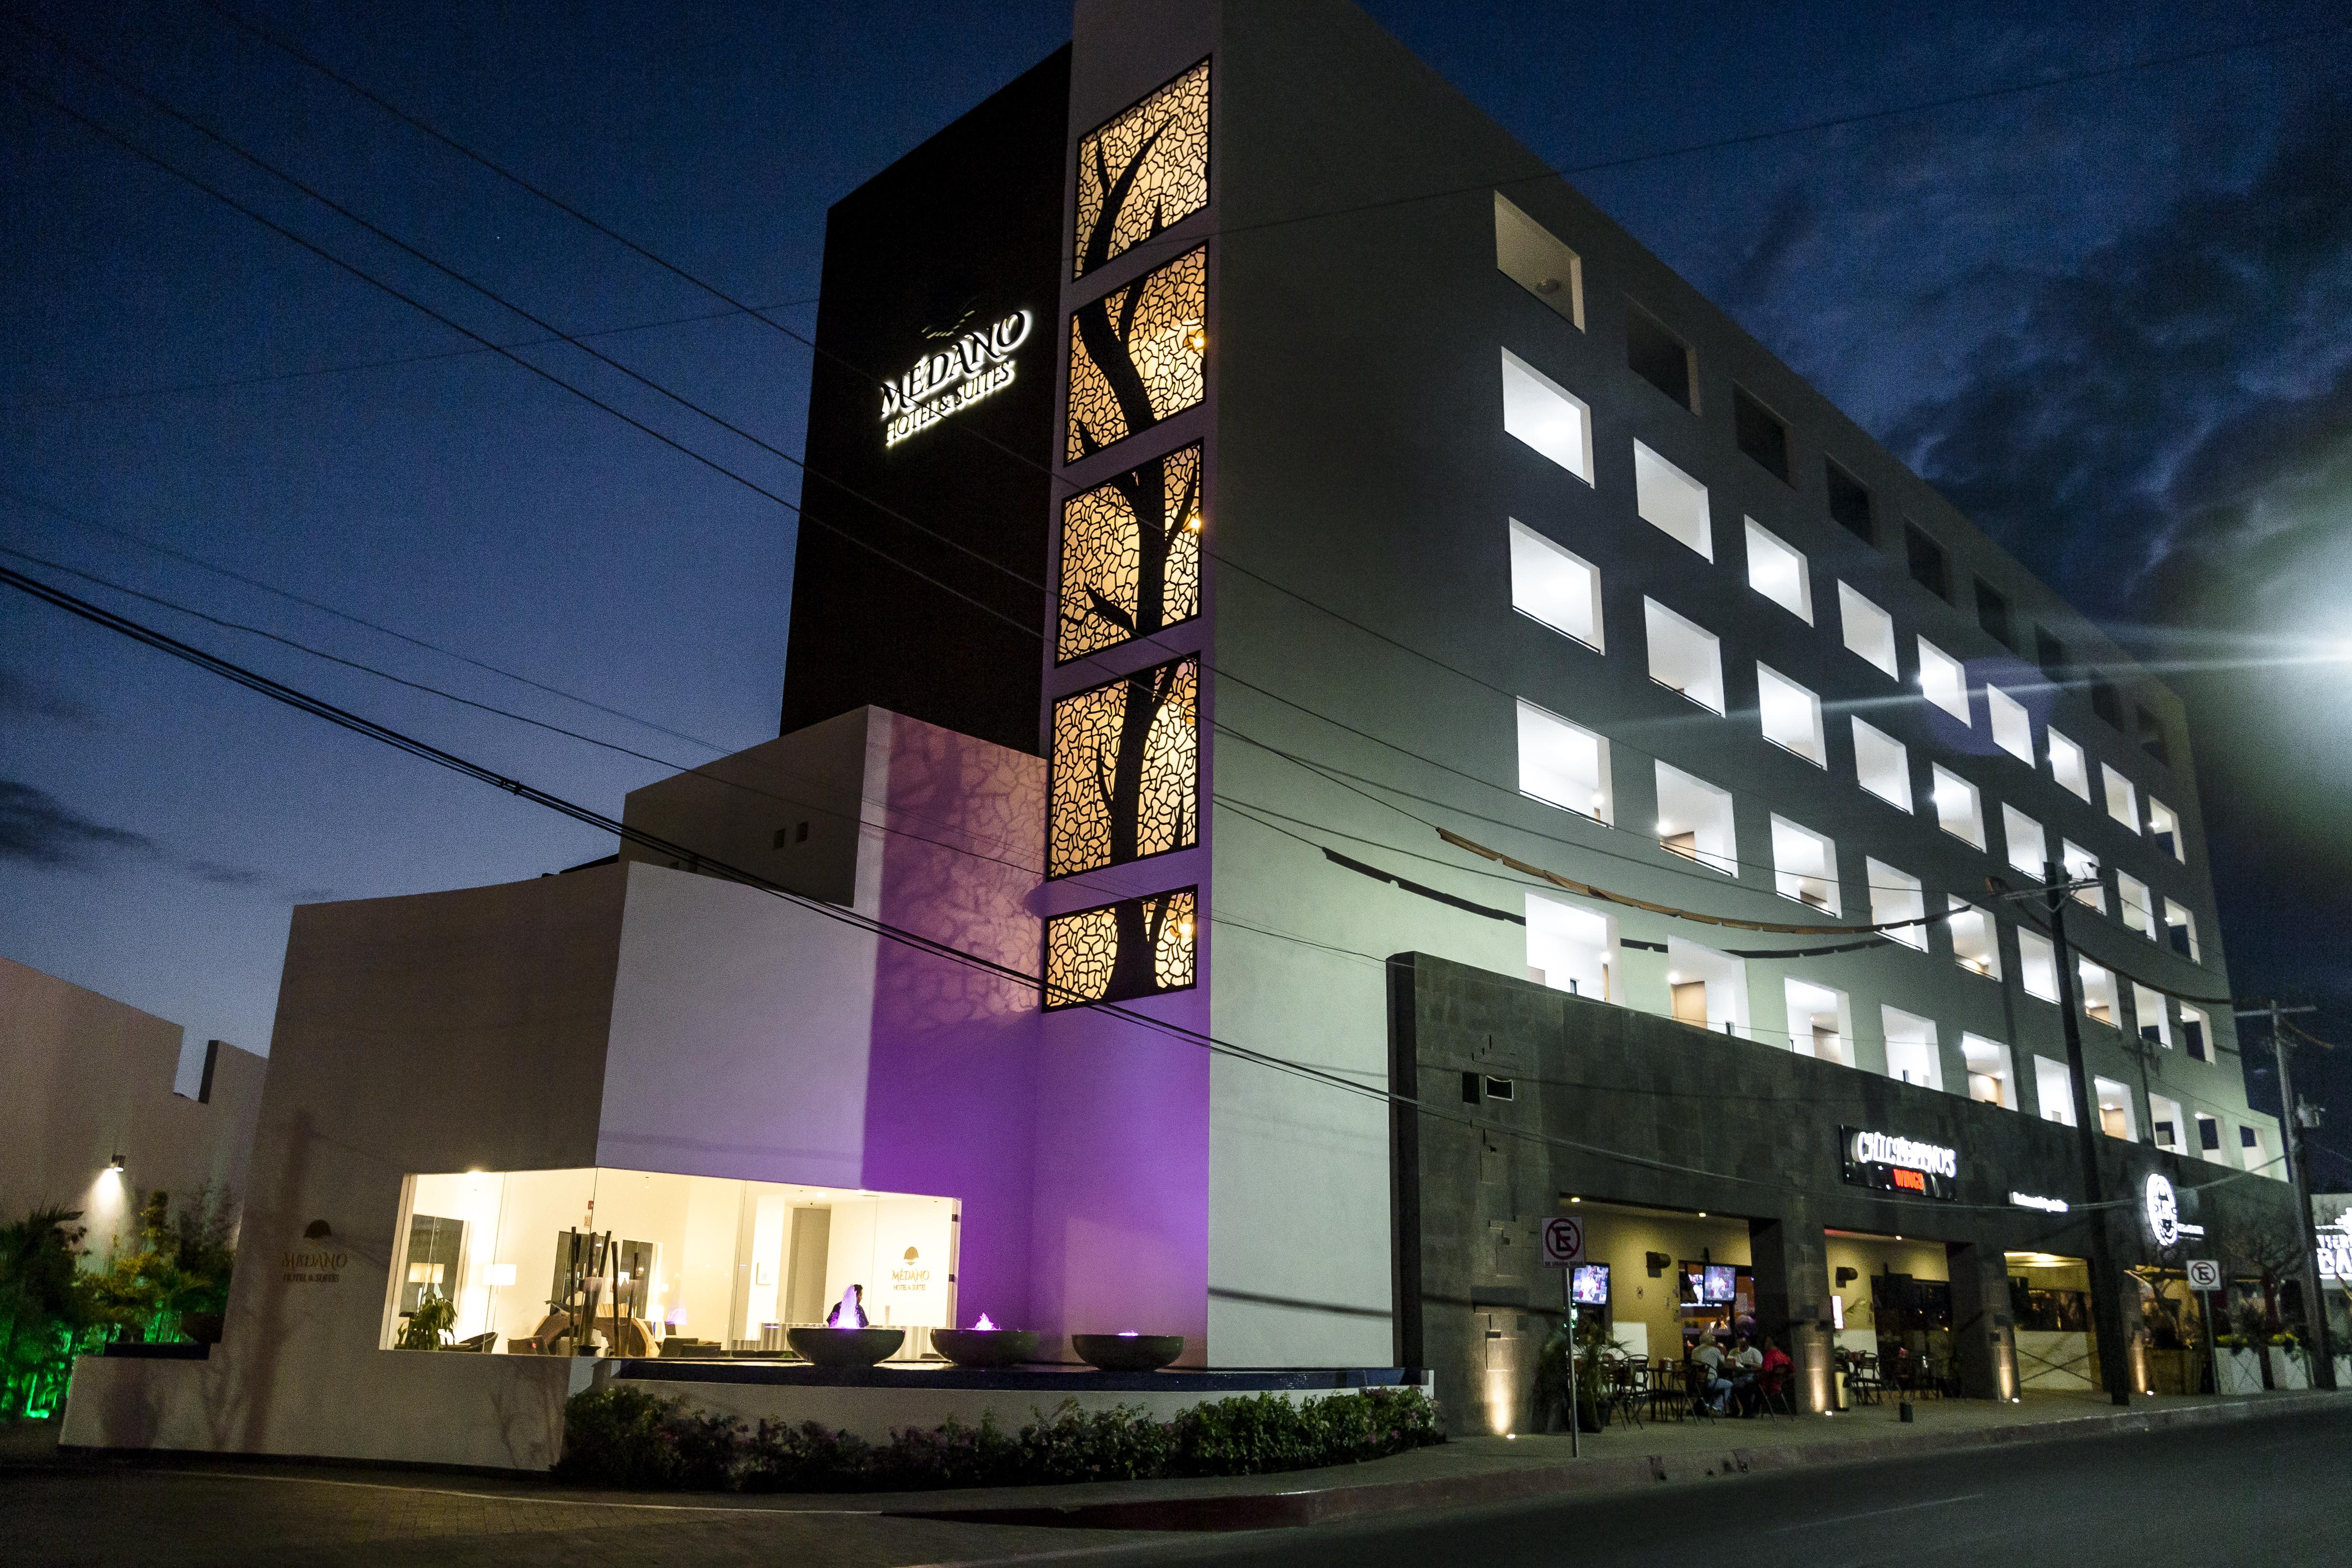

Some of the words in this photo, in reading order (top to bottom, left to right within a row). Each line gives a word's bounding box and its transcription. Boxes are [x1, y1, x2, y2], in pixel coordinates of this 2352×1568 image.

[885, 402, 939, 446] HOTEL
[939, 394, 952, 413] &
[955, 361, 1016, 410] SUITES
[1893, 1168, 1924, 1191] WINGS
[283, 1273, 306, 1283] HOTEL
[315, 1273, 340, 1283] SUITES
